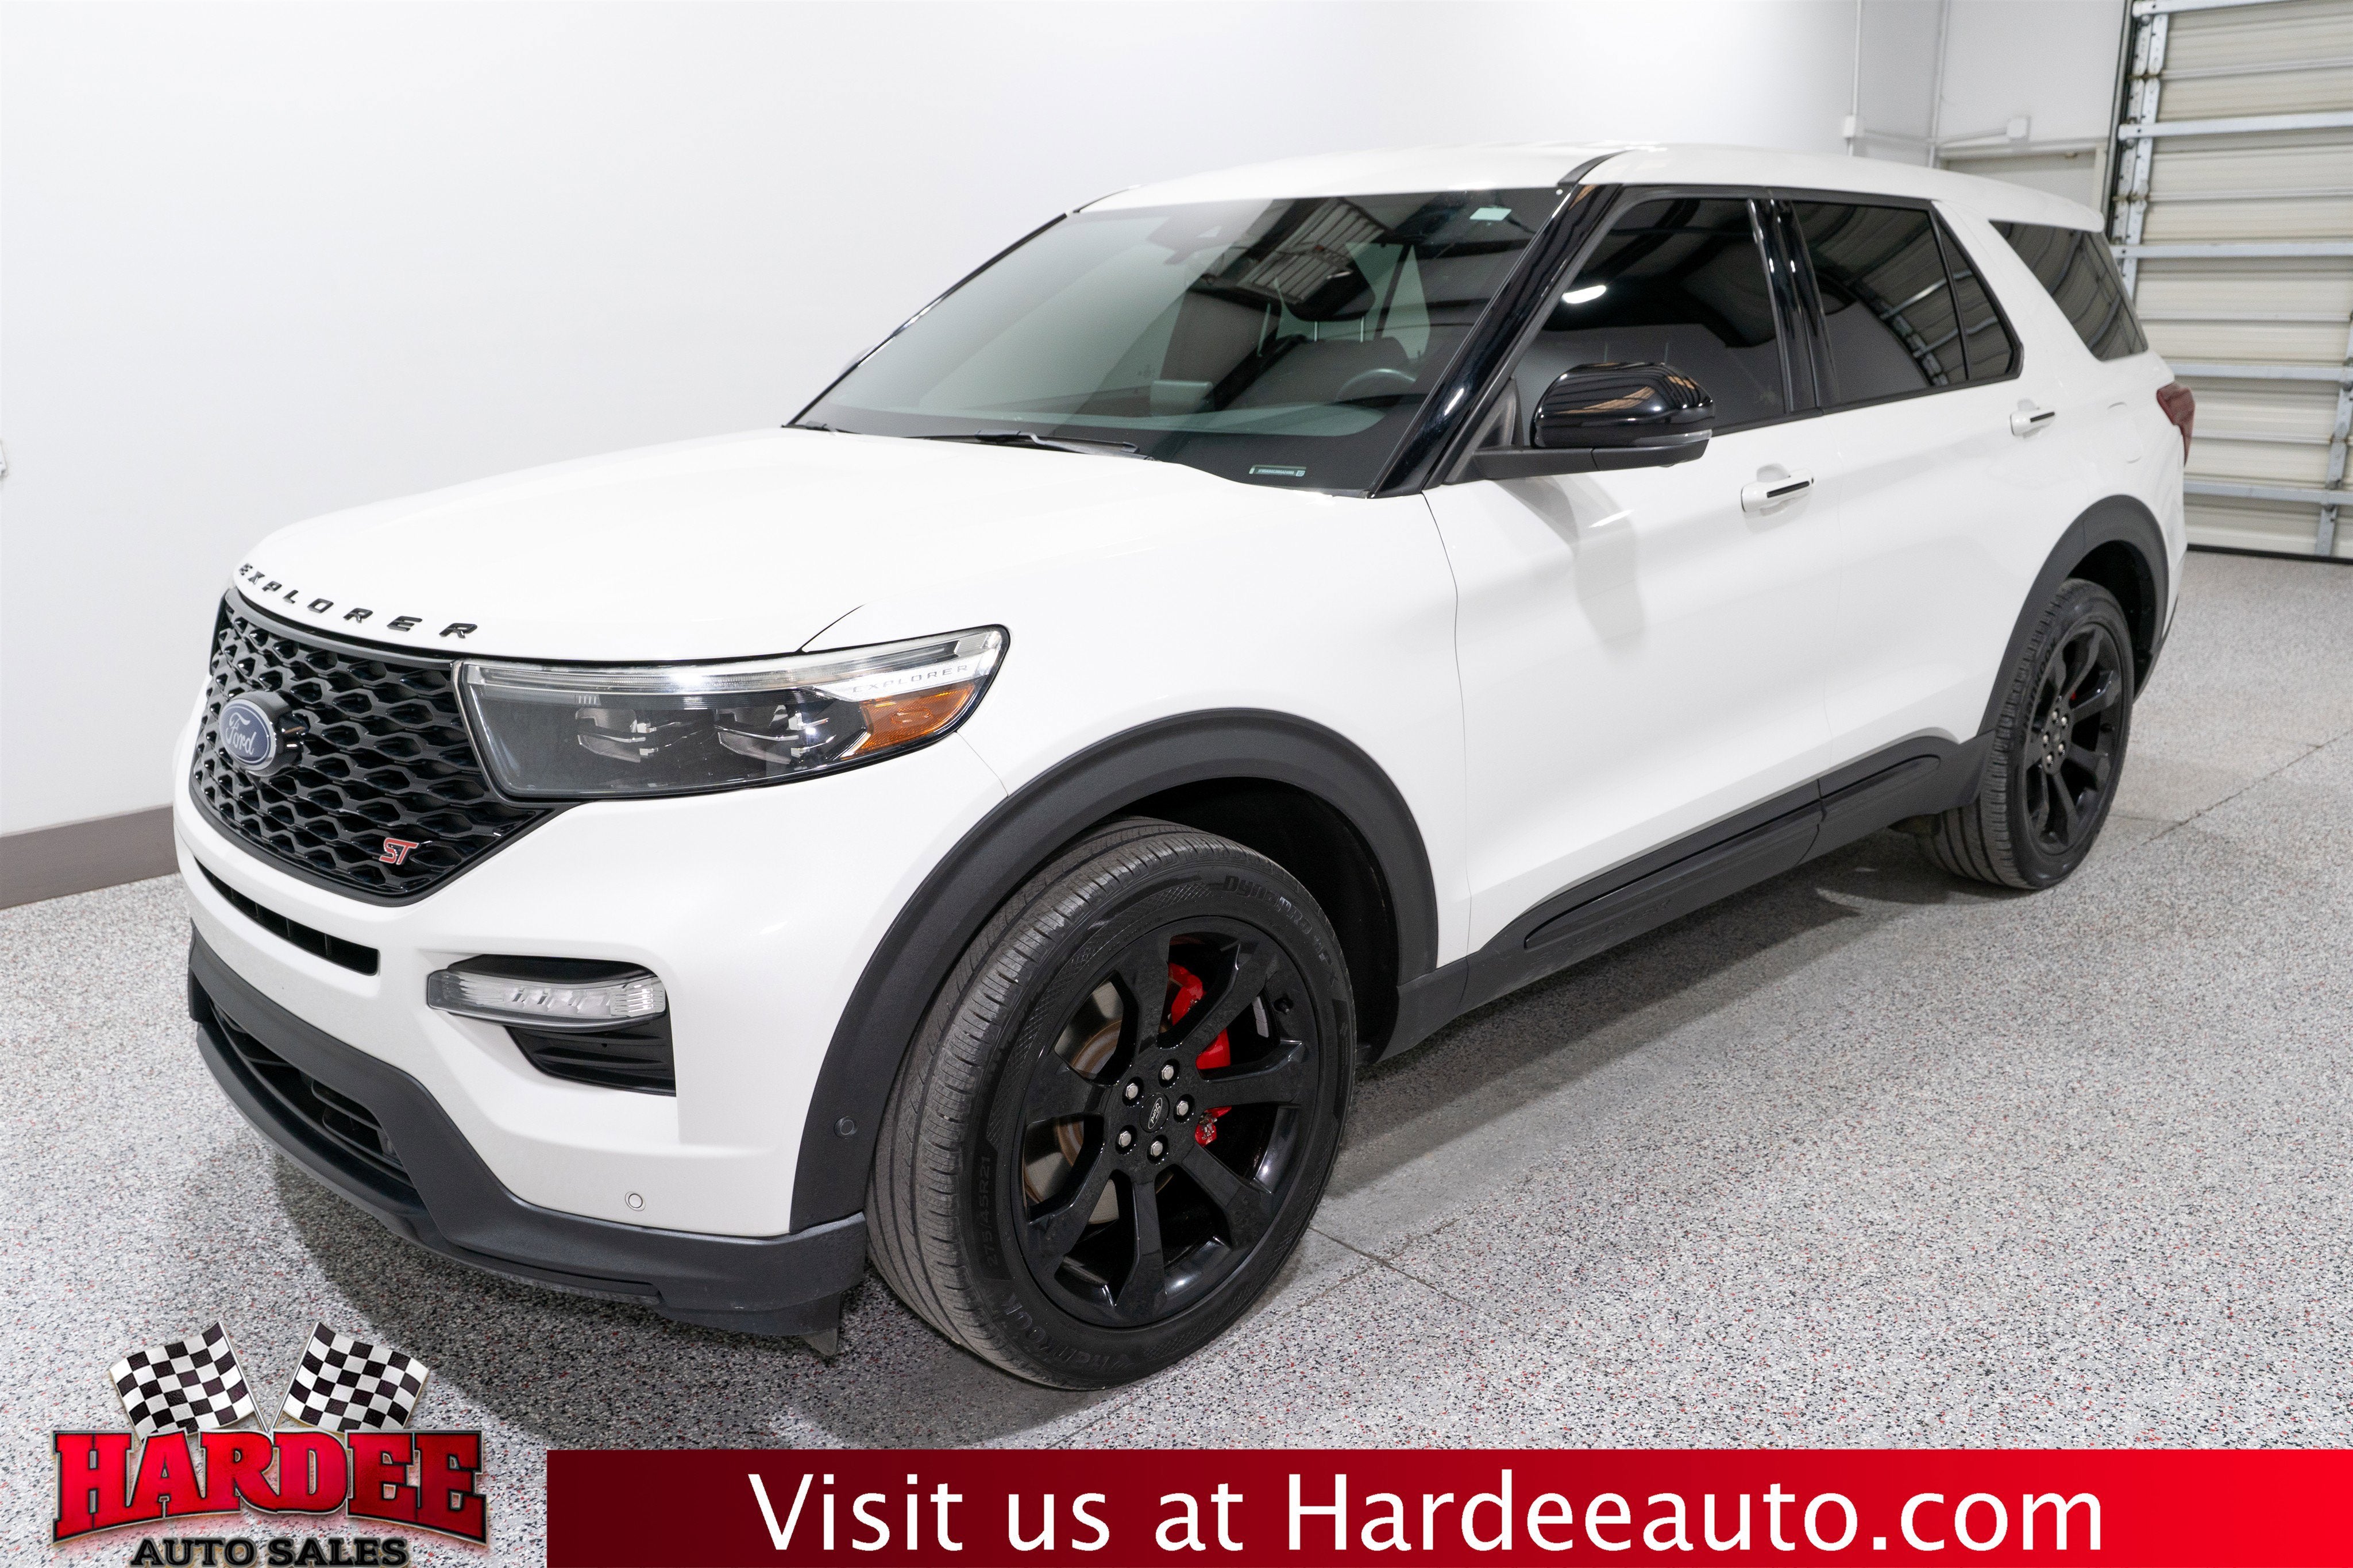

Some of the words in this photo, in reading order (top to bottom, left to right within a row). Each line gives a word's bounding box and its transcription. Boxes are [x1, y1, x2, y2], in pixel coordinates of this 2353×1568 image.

[239, 563, 477, 638] EXPLORER
[853, 665, 969, 693] EXPLORER
[226, 712, 257, 755] Ford
[379, 837, 419, 865] ST
[977, 1156, 998, 1266] 275/45R21
